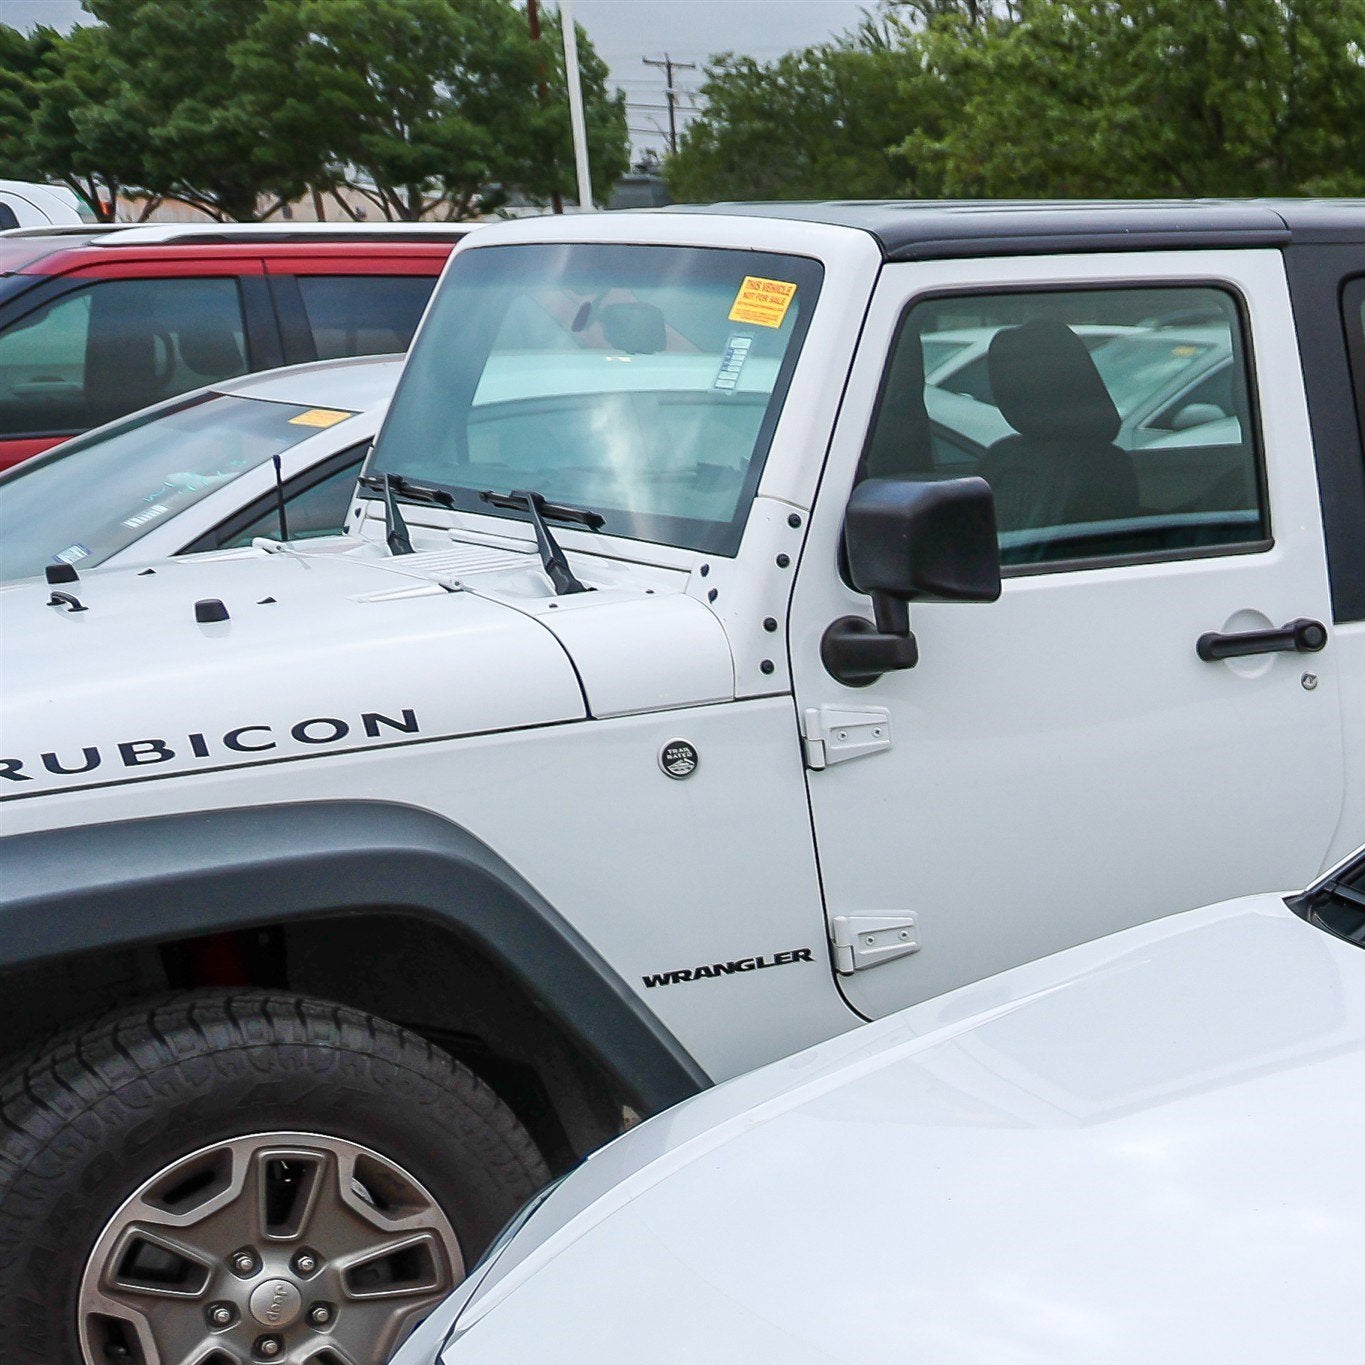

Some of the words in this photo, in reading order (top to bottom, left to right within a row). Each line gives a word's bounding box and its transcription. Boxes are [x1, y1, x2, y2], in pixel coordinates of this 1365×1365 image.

[0, 709, 419, 781] RUBICON
[642, 948, 816, 988] WRANGLER
[266, 1284, 288, 1322] Jeep
